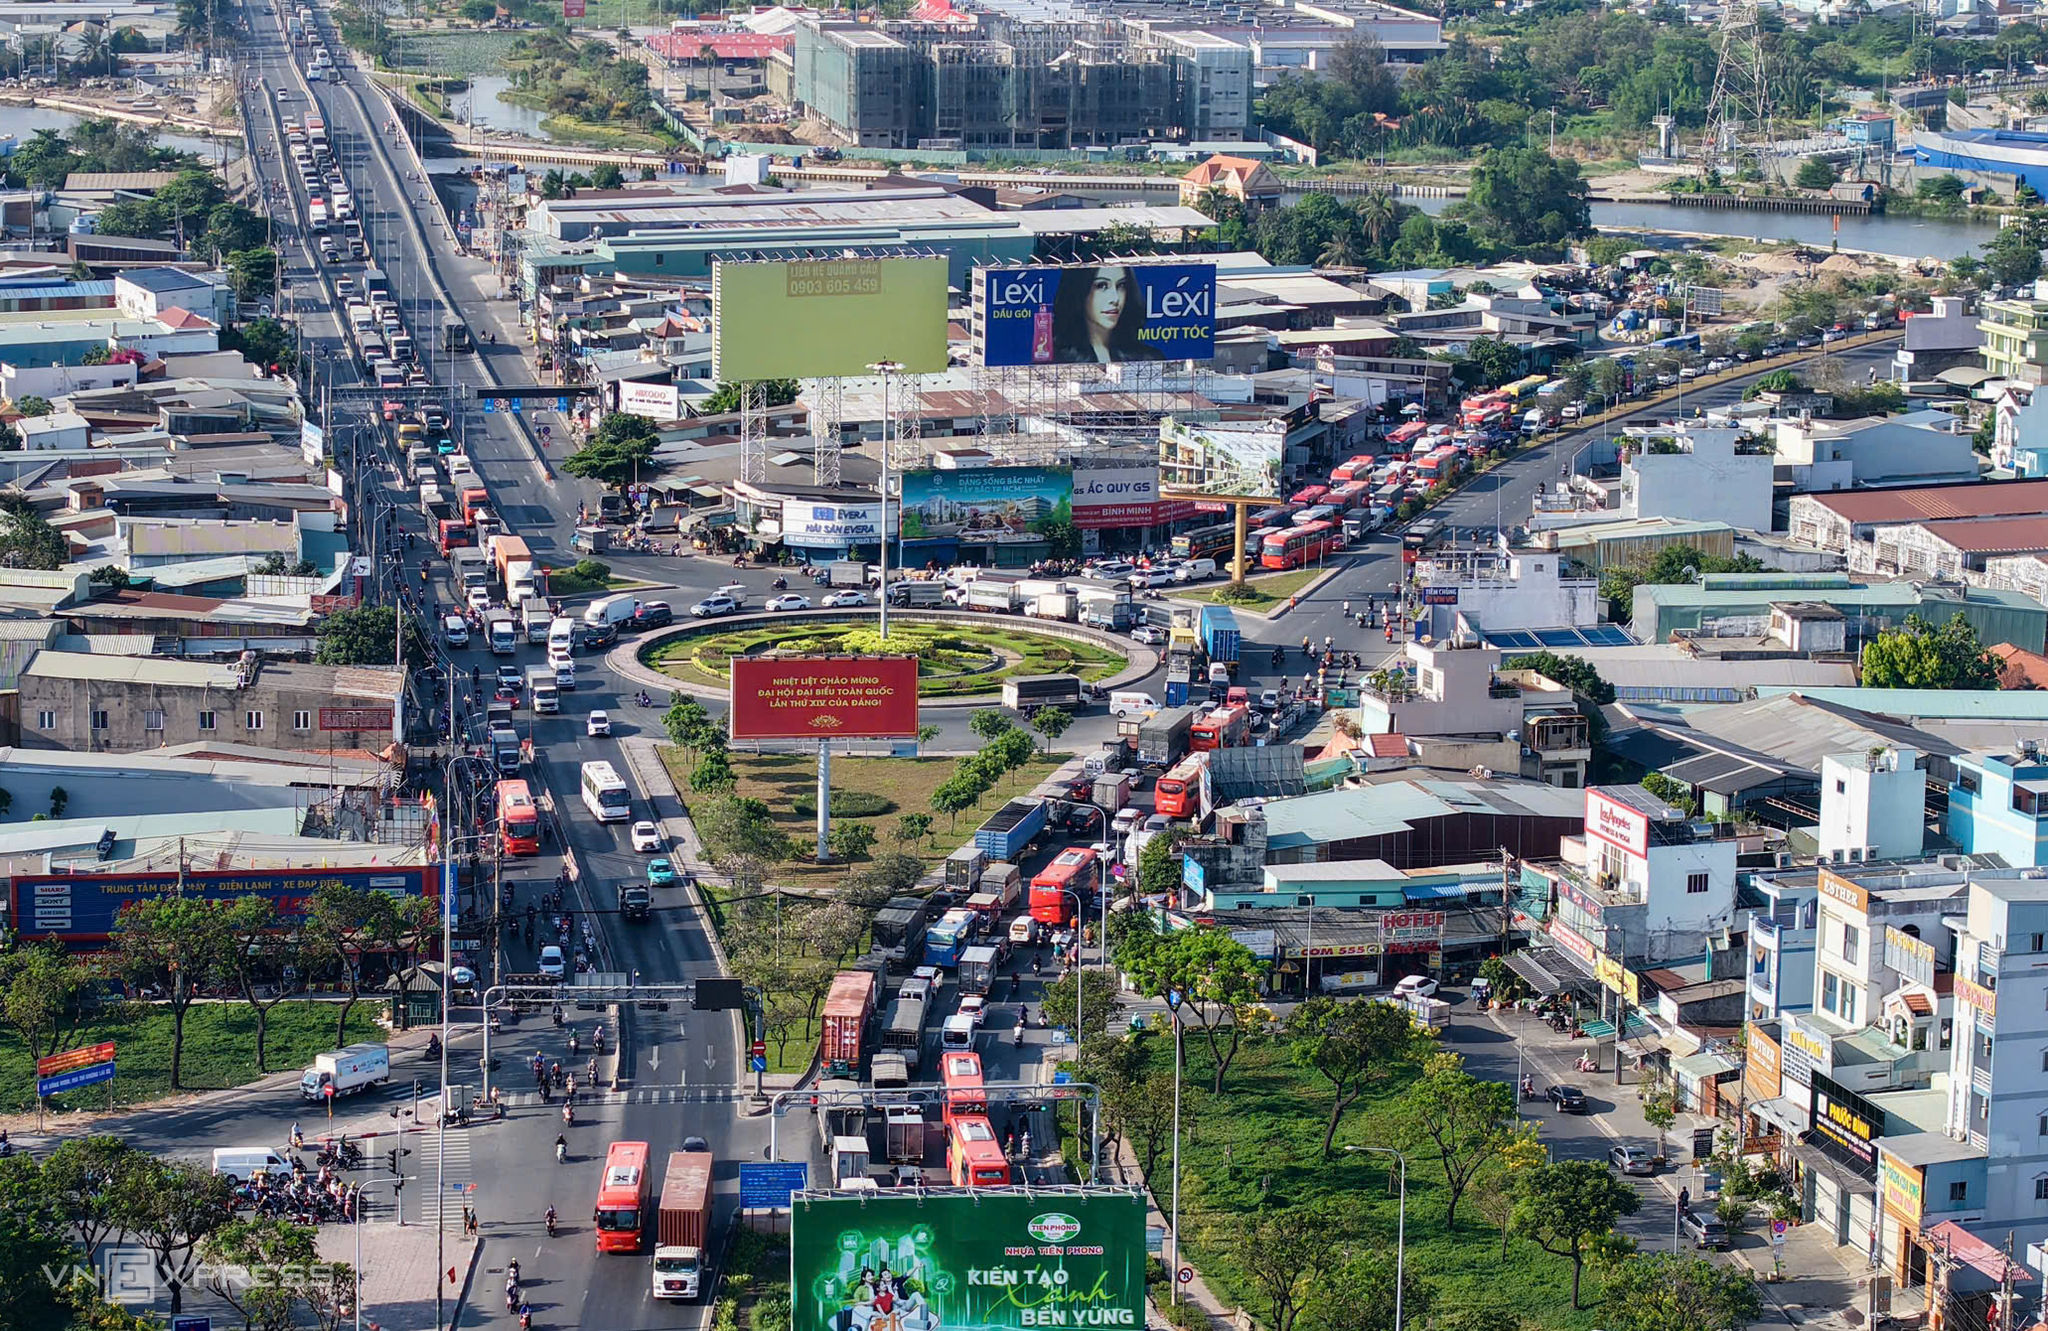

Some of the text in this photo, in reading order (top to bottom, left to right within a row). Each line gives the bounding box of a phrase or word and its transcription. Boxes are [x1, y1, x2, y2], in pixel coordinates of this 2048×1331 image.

[790, 278, 878, 295] 0903 605 459
[992, 271, 1043, 306] Léxi
[1146, 276, 1210, 319] Léxi
[993, 308, 1013, 319] DẦU
[1137, 324, 1210, 343] MƯỢT TÓC
[984, 476, 1006, 486] SỐNG
[1025, 474, 1045, 484] NHẤT
[1074, 480, 1151, 495] GS ẮC QUY GS
[838, 509, 867, 520] EVERA
[1102, 506, 1126, 516] BÌNH
[1127, 506, 1152, 515] MINH
[844, 524, 875, 534] EVERA
[773, 675, 879, 686] NHIỆT LIỆT CHÀO MỪNG
[758, 685, 894, 698] ĐẠI HỘI ĐẠI BIỂU TOÀN QUỐC
[790, 697, 807, 707] THỨ
[828, 697, 849, 707] CỦA
[851, 697, 882, 707] ĐẢNG!
[100, 884, 134, 894] TRUNG
[136, 881, 158, 893] TÂM
[218, 880, 243, 892] ĐIỆN
[245, 880, 271, 892] LẠNH
[283, 880, 295, 889] XE
[297, 880, 317, 890] ĐẠP
[1823, 879, 1858, 907] ESTHER
[1339, 945, 1365, 955] 555
[1828, 1102, 1853, 1129] PHƯỚC
[1852, 1114, 1870, 1140] BÌNH
[1004, 1245, 1035, 1258] NHỰA
[1067, 1245, 1104, 1255] PHONG
[968, 1263, 1069, 1288] KIẾN TẠO
[985, 1263, 1118, 1323] Xanh
[1021, 1304, 1135, 1326] BỀN VỮNG
